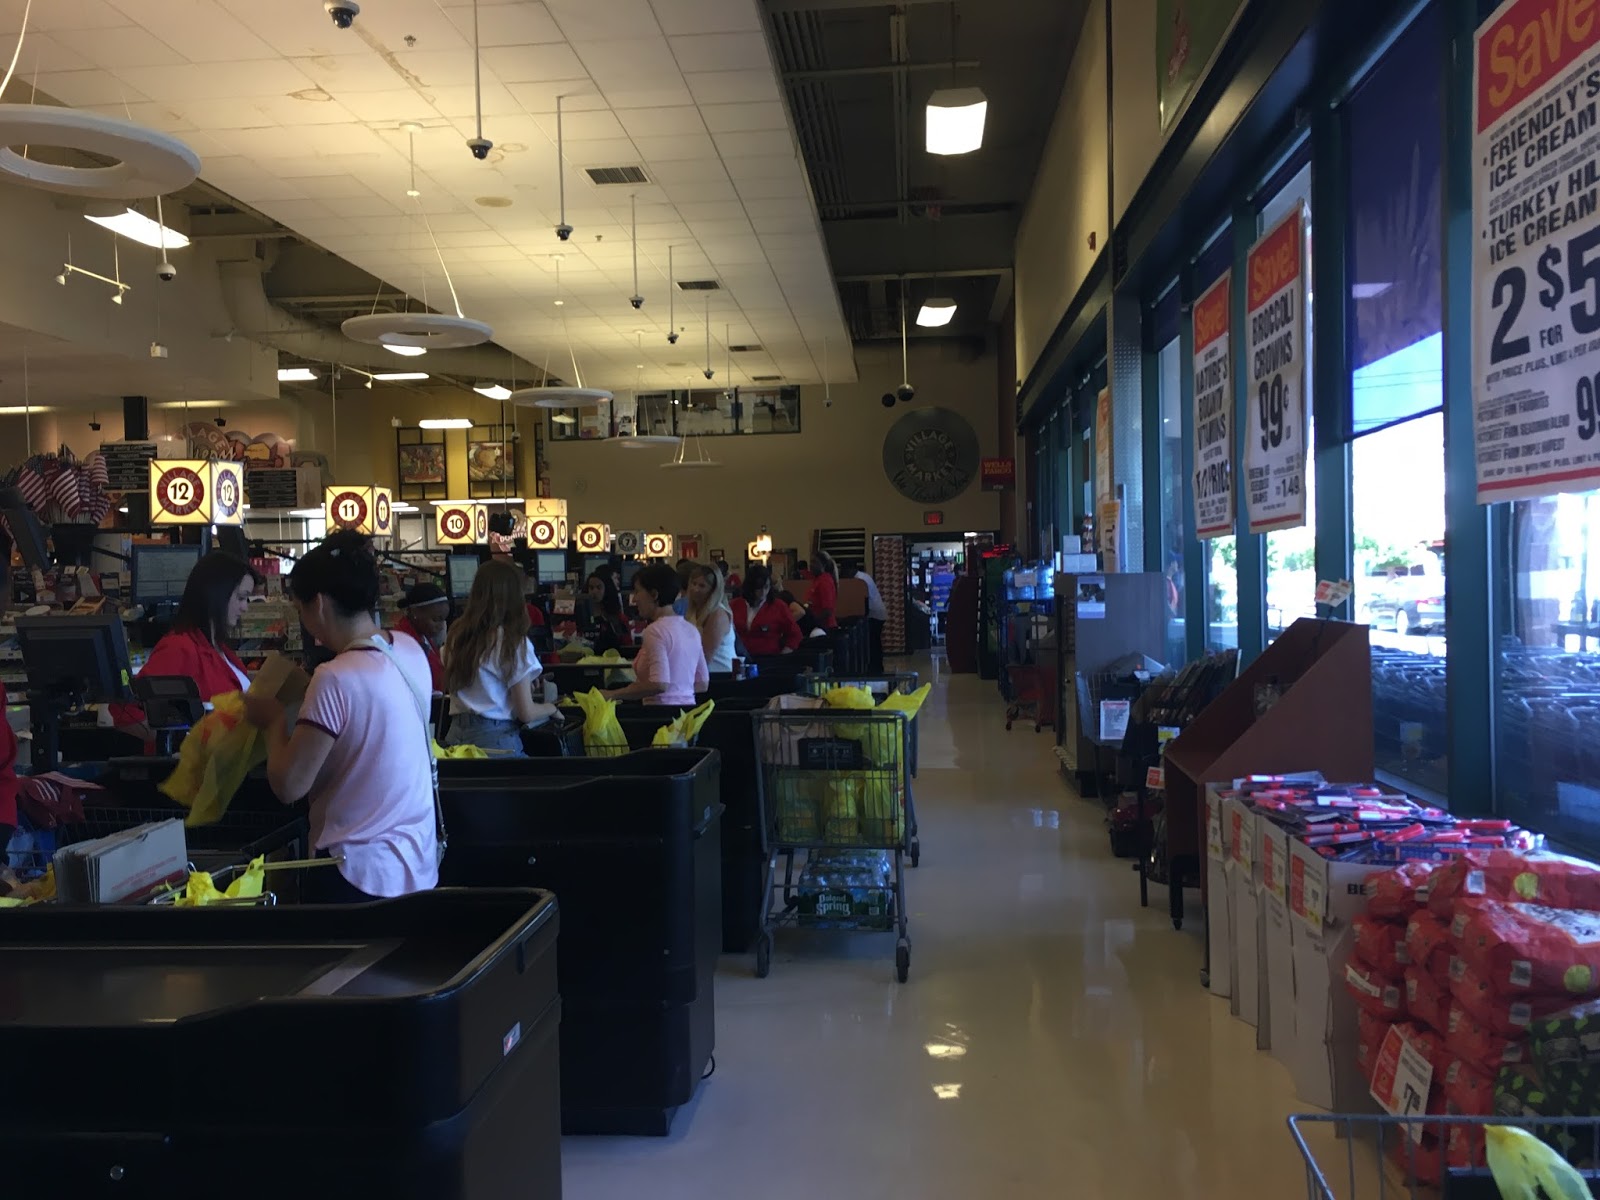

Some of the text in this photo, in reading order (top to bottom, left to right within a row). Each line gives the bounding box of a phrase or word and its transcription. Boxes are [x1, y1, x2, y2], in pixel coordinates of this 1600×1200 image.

[1488, 0, 1596, 108] Save
[1489, 69, 1600, 167] FRIENDLY'S
[1489, 156, 1518, 193] ICE
[1524, 101, 1597, 168] CREAM
[1489, 180, 1560, 240] TURKEY
[1489, 188, 1597, 266] ICE CREAM
[1253, 223, 1295, 302] Save!
[1252, 287, 1294, 347] BROCCOLI
[1490, 266, 1530, 366] 2
[1539, 323, 1564, 348] FOR
[1254, 330, 1293, 381] CROWNS
[905, 430, 954, 453] VILLAGE
[907, 460, 955, 482] MARKET
[983, 461, 1012, 469] WELLS
[159, 470, 200, 487] VILLAGE
[170, 482, 189, 500] 12
[223, 484, 233, 501] 12
[160, 496, 199, 515] MARKET
[342, 503, 355, 517] 11
[449, 518, 463, 530] 10
[539, 527, 546, 537] 9
[587, 532, 594, 542] 8
[624, 538, 631, 546] 7
[818, 893, 847, 904] Poland
[815, 901, 851, 917] Spring
